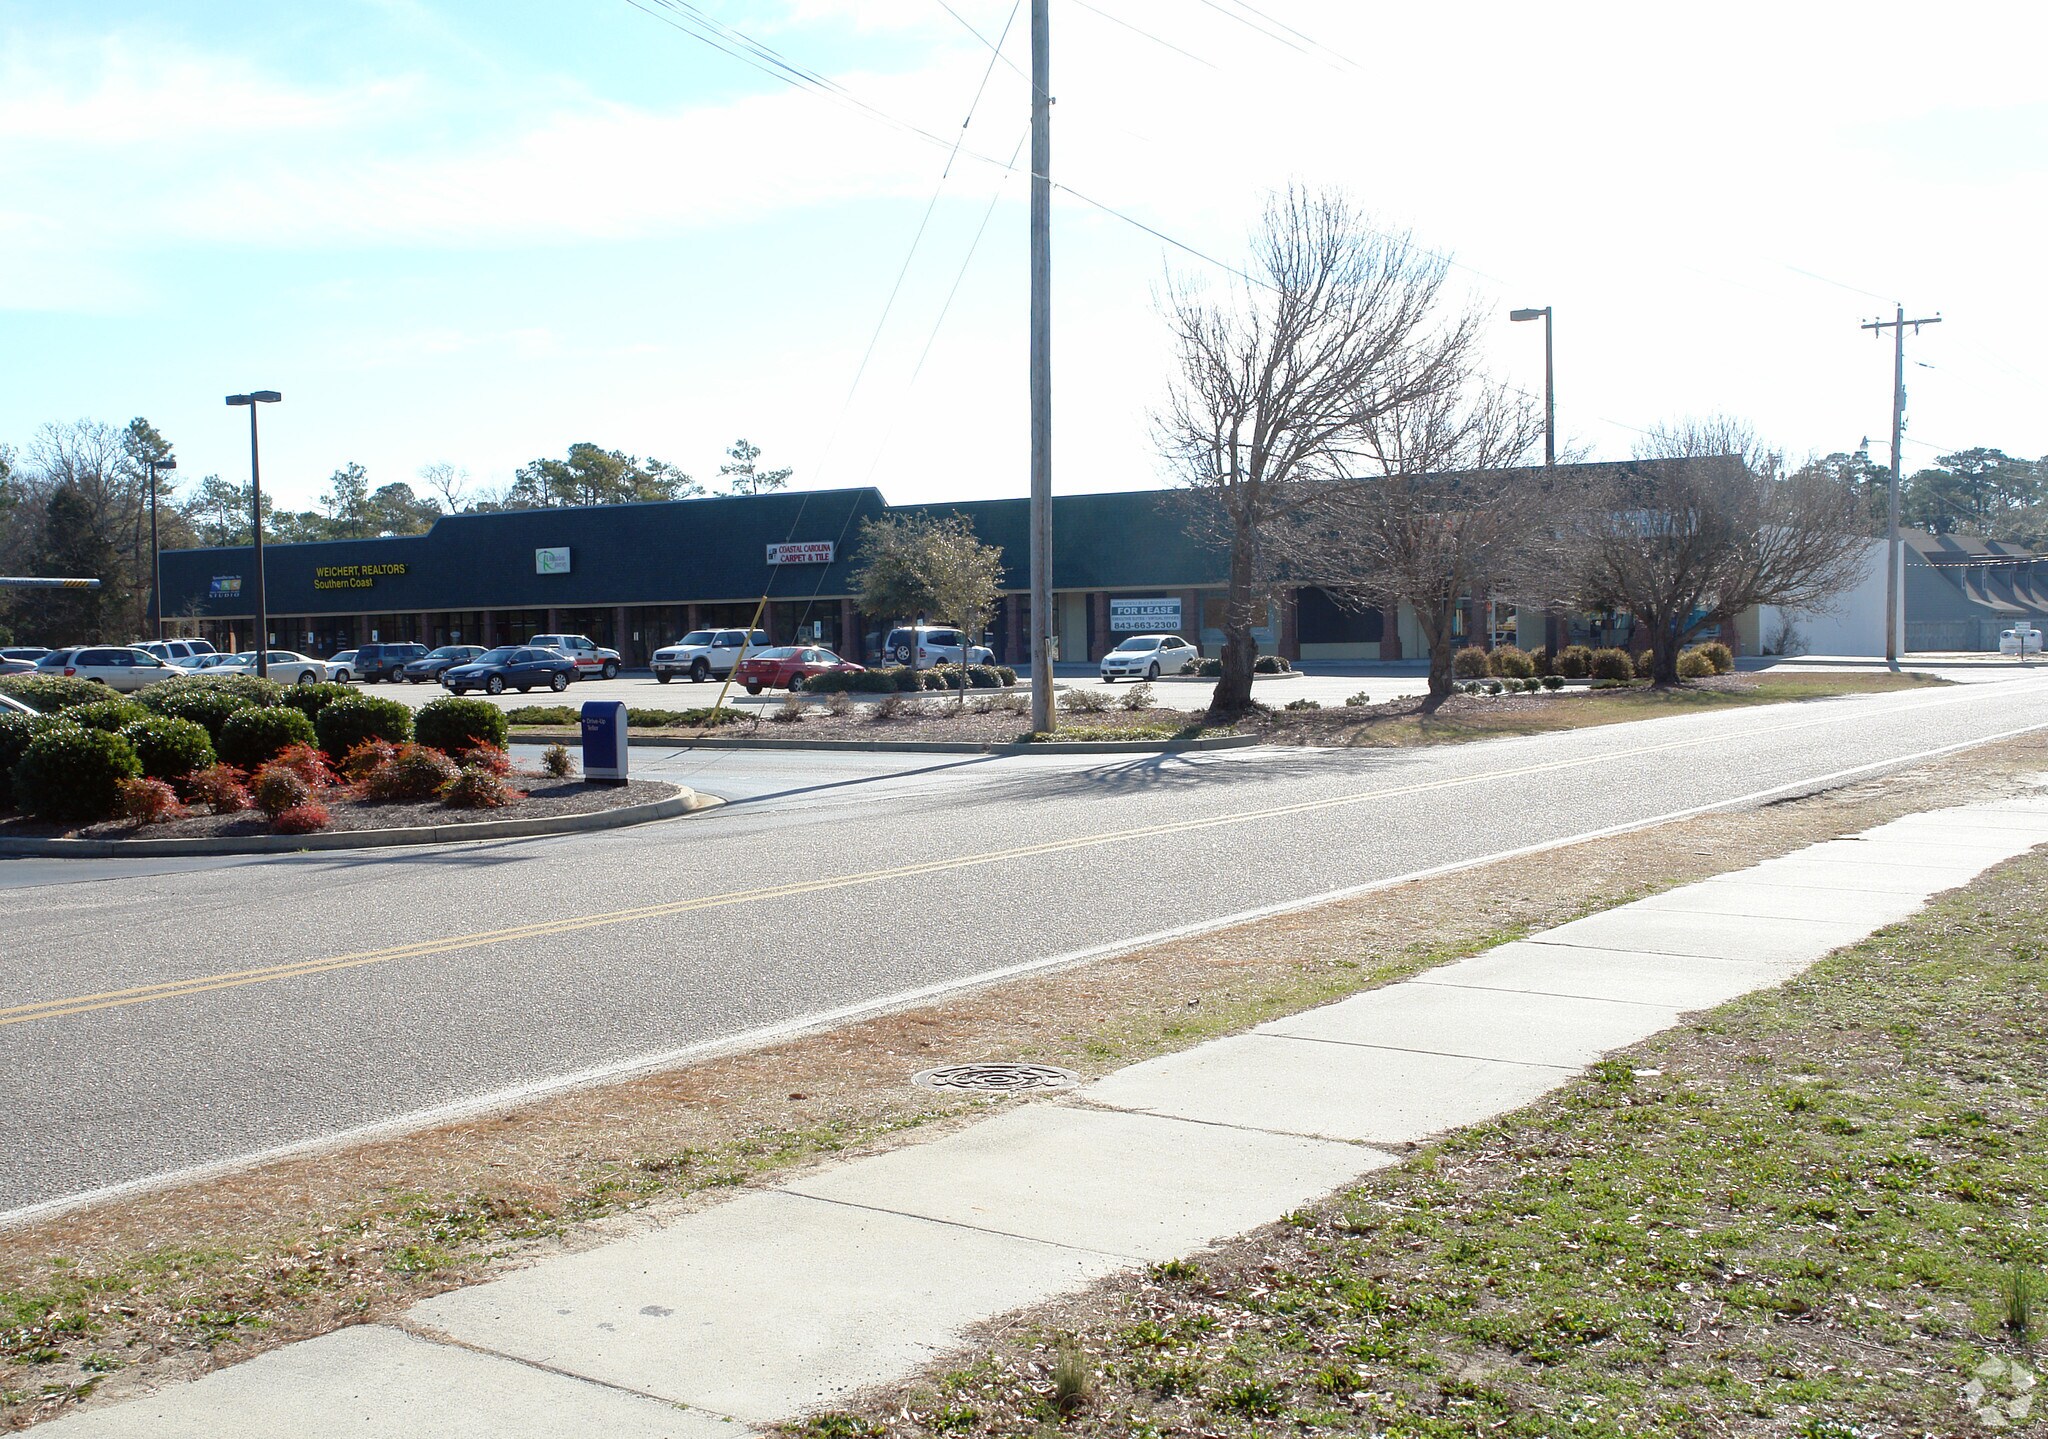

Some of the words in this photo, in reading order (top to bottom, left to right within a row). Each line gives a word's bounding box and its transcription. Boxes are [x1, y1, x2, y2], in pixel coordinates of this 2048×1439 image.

[779, 545, 803, 554] COASTAL
[804, 544, 831, 553] CAROLINA
[780, 554, 806, 563] CARPET
[808, 553, 814, 561] &
[815, 552, 829, 561] TILE
[315, 566, 360, 577] WEICHERT,
[361, 564, 405, 575] REALTORS
[314, 579, 349, 590] Southern
[349, 577, 373, 588] Coast
[1117, 607, 1139, 615] FOR
[1140, 606, 1174, 615] LEASE
[1114, 621, 1178, 630] 843-663-2300
